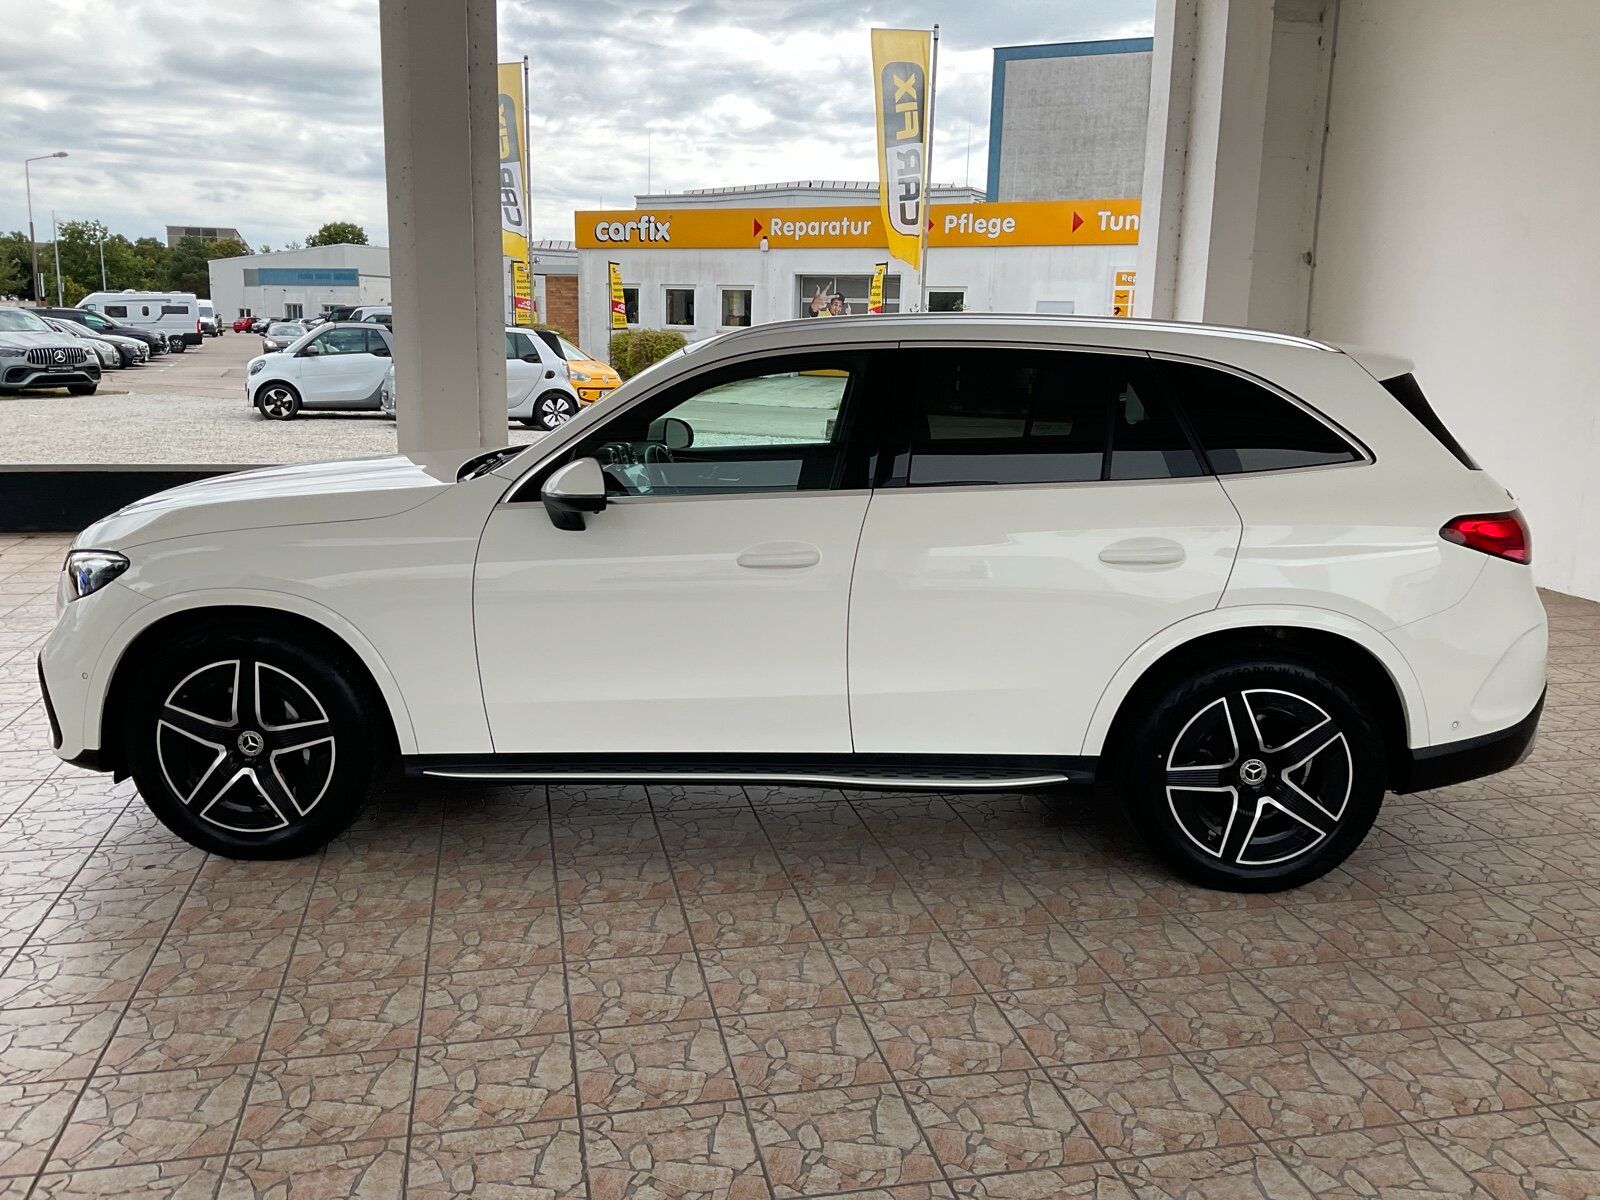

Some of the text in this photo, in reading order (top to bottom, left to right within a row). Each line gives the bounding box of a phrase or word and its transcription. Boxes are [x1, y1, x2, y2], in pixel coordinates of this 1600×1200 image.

[595, 215, 671, 242] carfix
[770, 217, 872, 240] Reparatur
[944, 213, 1016, 239] Pflege
[1097, 210, 1140, 231] Tun
